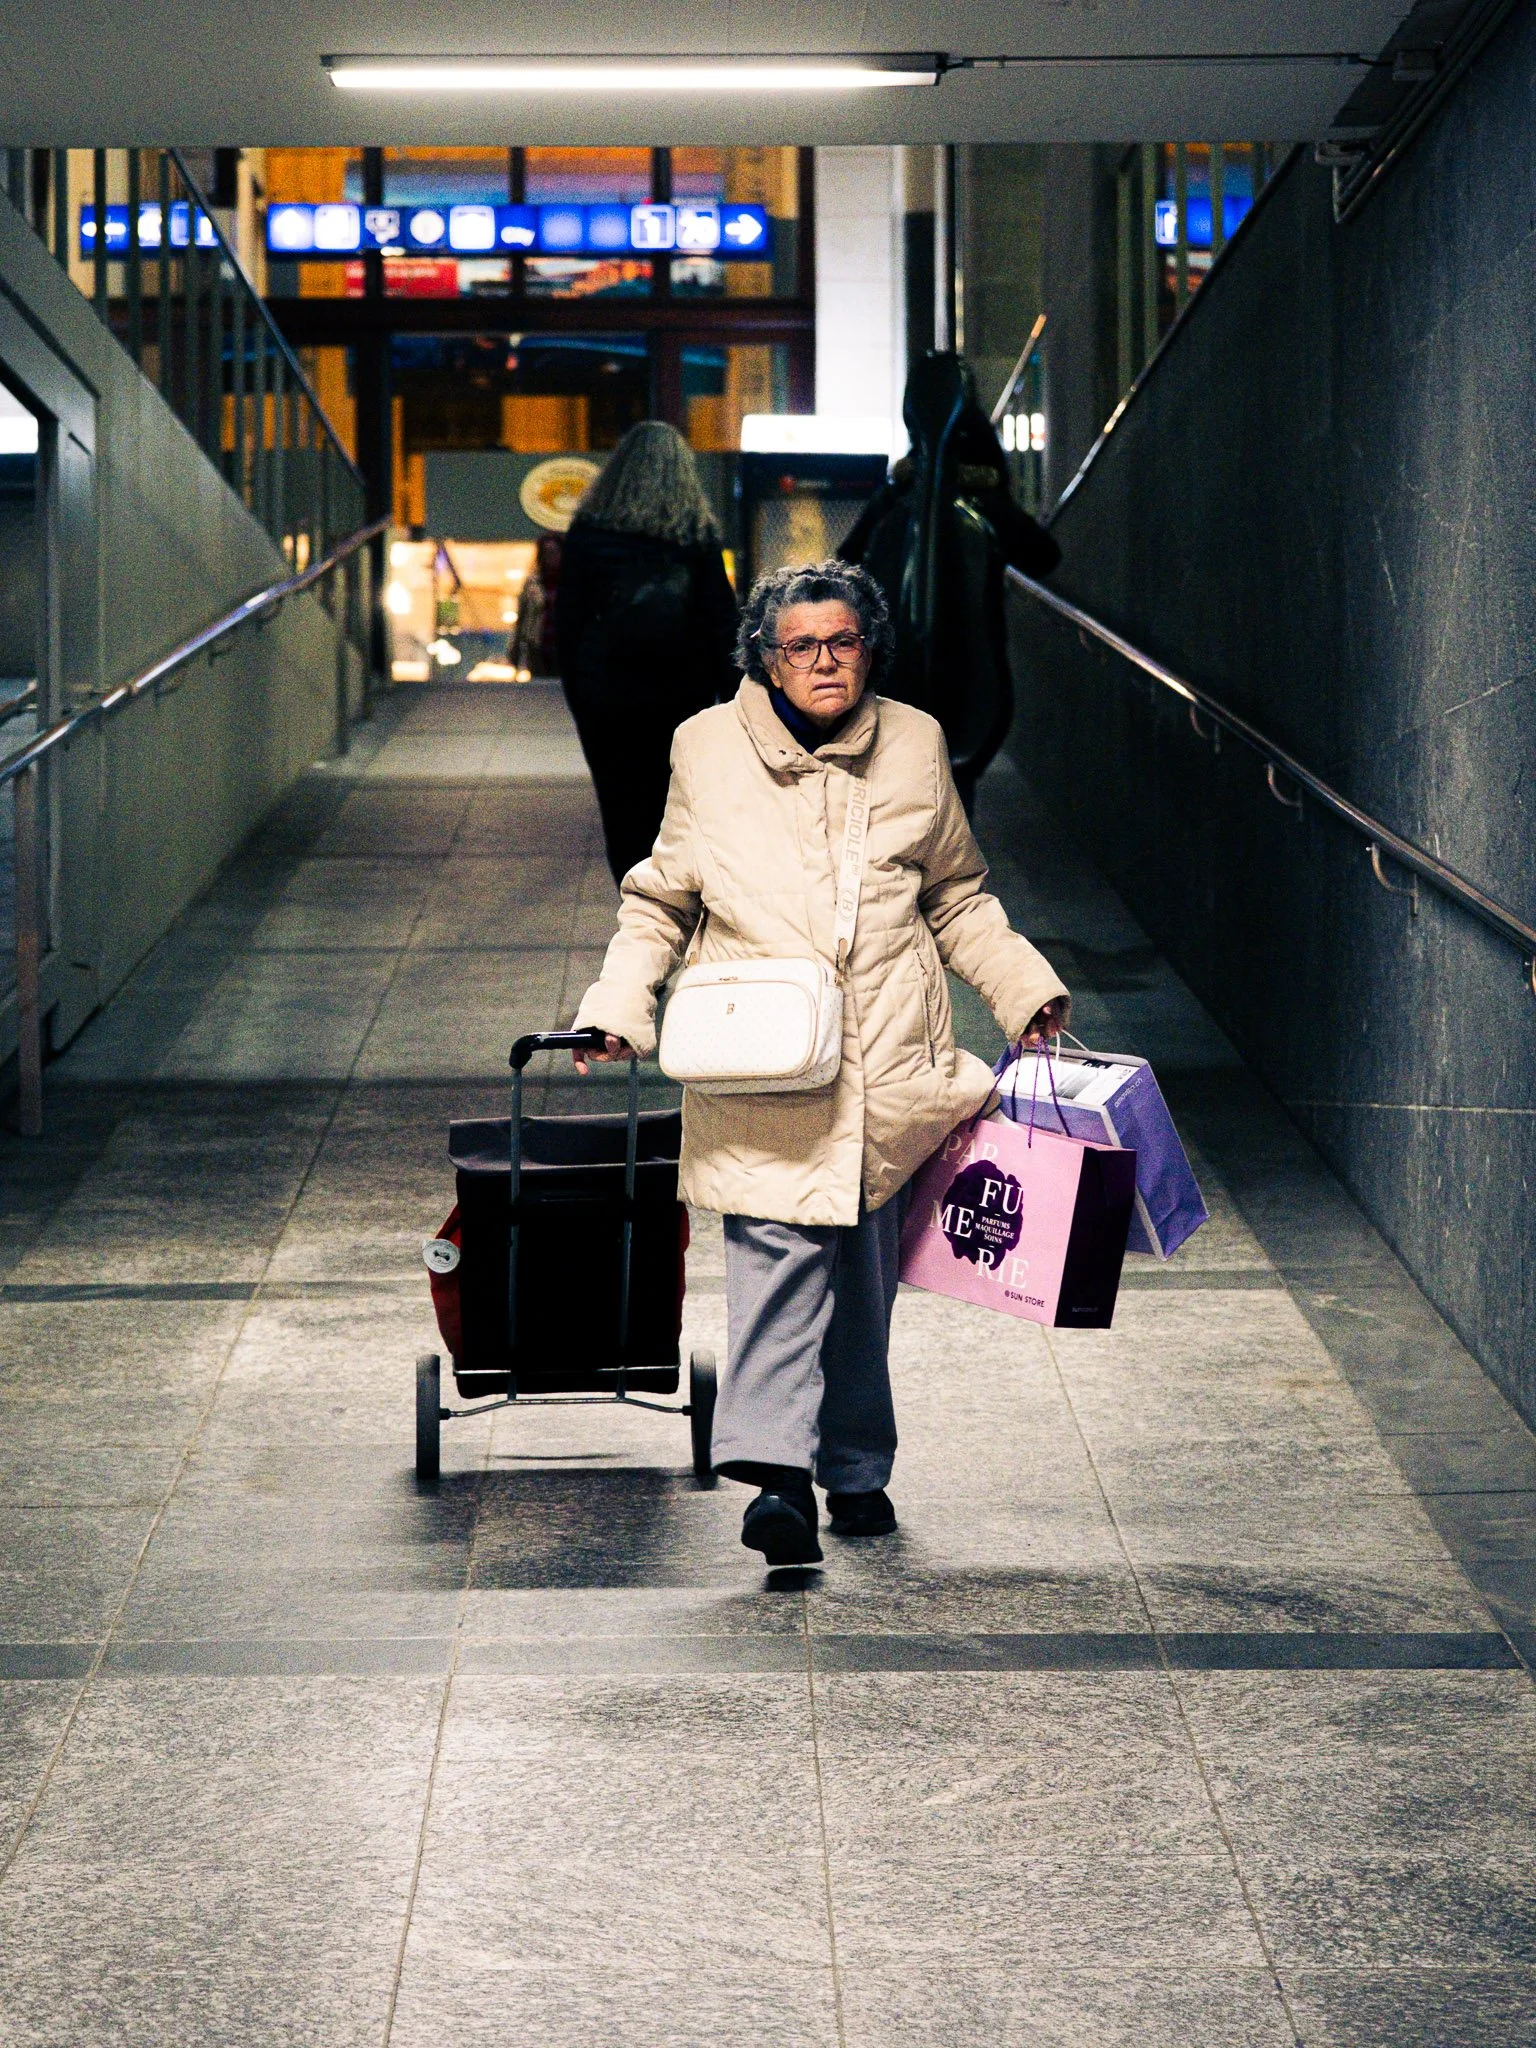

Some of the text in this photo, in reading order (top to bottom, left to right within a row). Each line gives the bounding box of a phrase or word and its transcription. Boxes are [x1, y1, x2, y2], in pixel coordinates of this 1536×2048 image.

[979, 1178, 1024, 1215] FU
[928, 1200, 975, 1239] ME
[981, 1216, 1011, 1230] PARFUMS
[975, 1222, 1015, 1239] MAQUILLAGE
[984, 1233, 1003, 1244] SOINS
[976, 1247, 1030, 1289] RIE
[1010, 1291, 1046, 1308] SUN STORE
